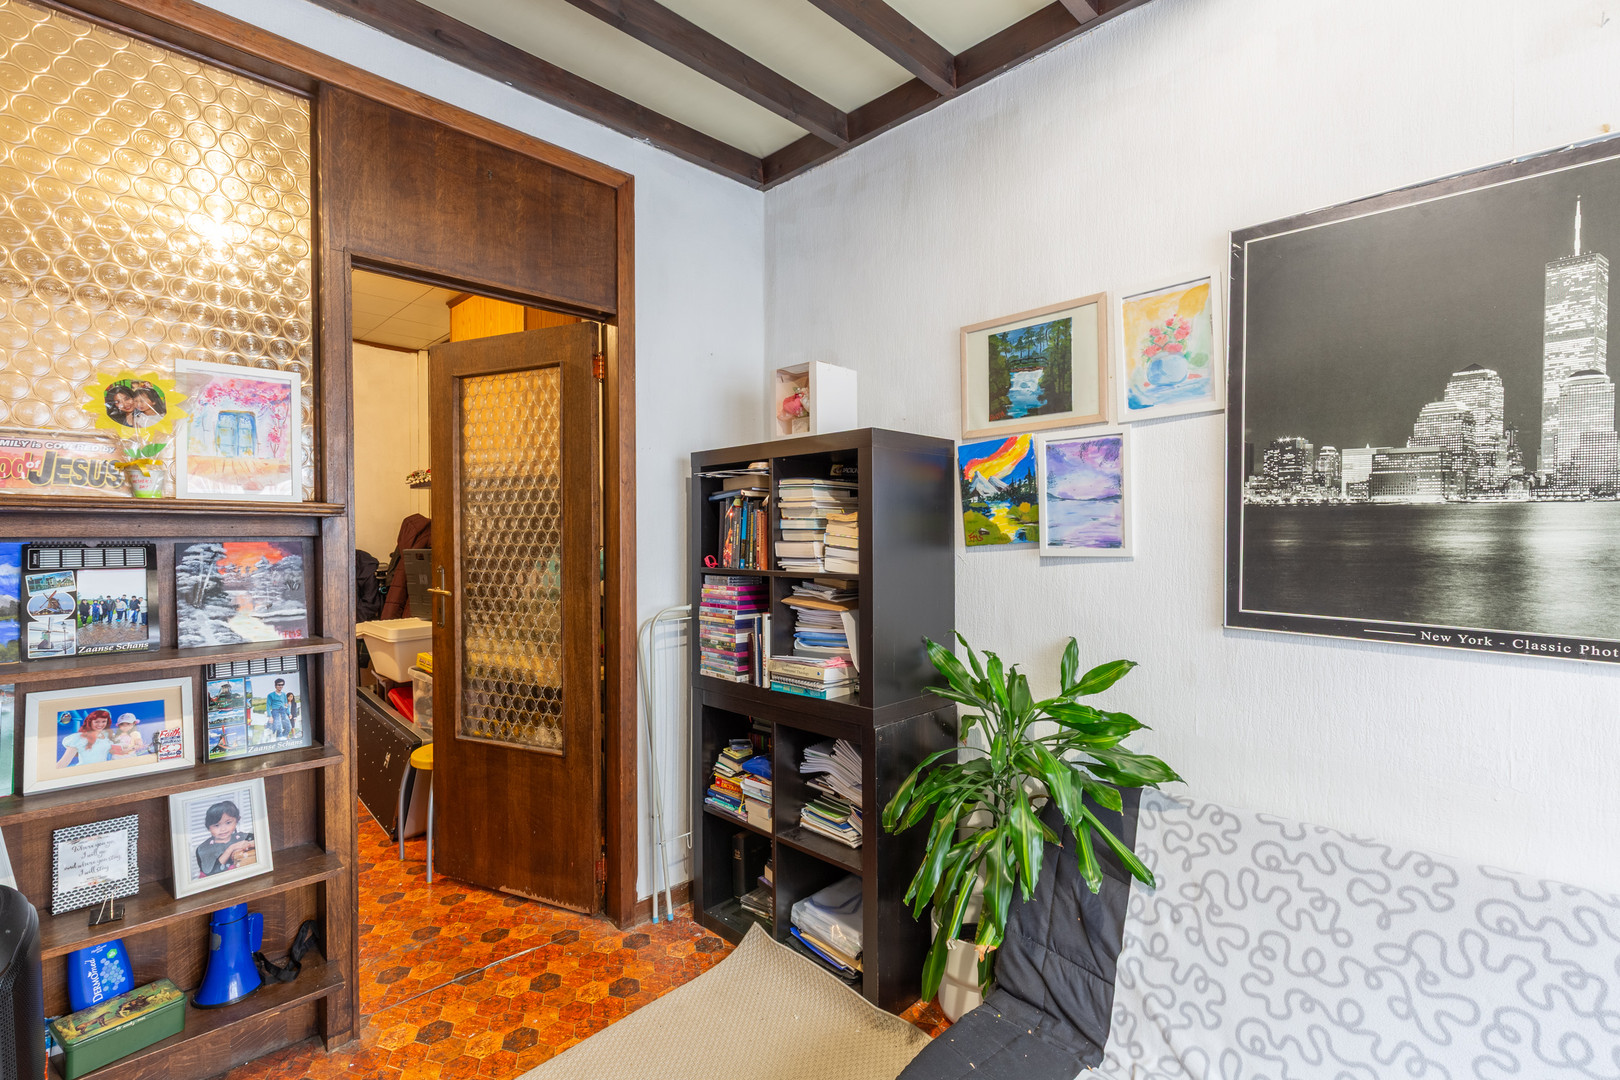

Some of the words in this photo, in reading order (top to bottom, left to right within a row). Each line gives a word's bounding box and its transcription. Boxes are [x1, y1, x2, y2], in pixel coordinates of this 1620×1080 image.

[45, 442, 101, 452] COVERED
[102, 445, 115, 454] by
[26, 461, 41, 471] of
[28, 450, 124, 488] JESUS
[78, 645, 115, 654] Zaanse
[116, 642, 149, 651] Schans
[1420, 631, 1452, 643] New
[1457, 633, 1493, 647] York
[1512, 639, 1572, 654] Classic
[1579, 644, 1620, 658] Phot
[160, 727, 181, 738] Faith
[248, 744, 276, 753] Zaanse
[277, 739, 303, 748] Schans
[87, 848, 98, 858] will
[64, 862, 78, 871] and
[78, 860, 96, 869] where
[85, 866, 96, 875] will
[96, 865, 110, 873] stay
